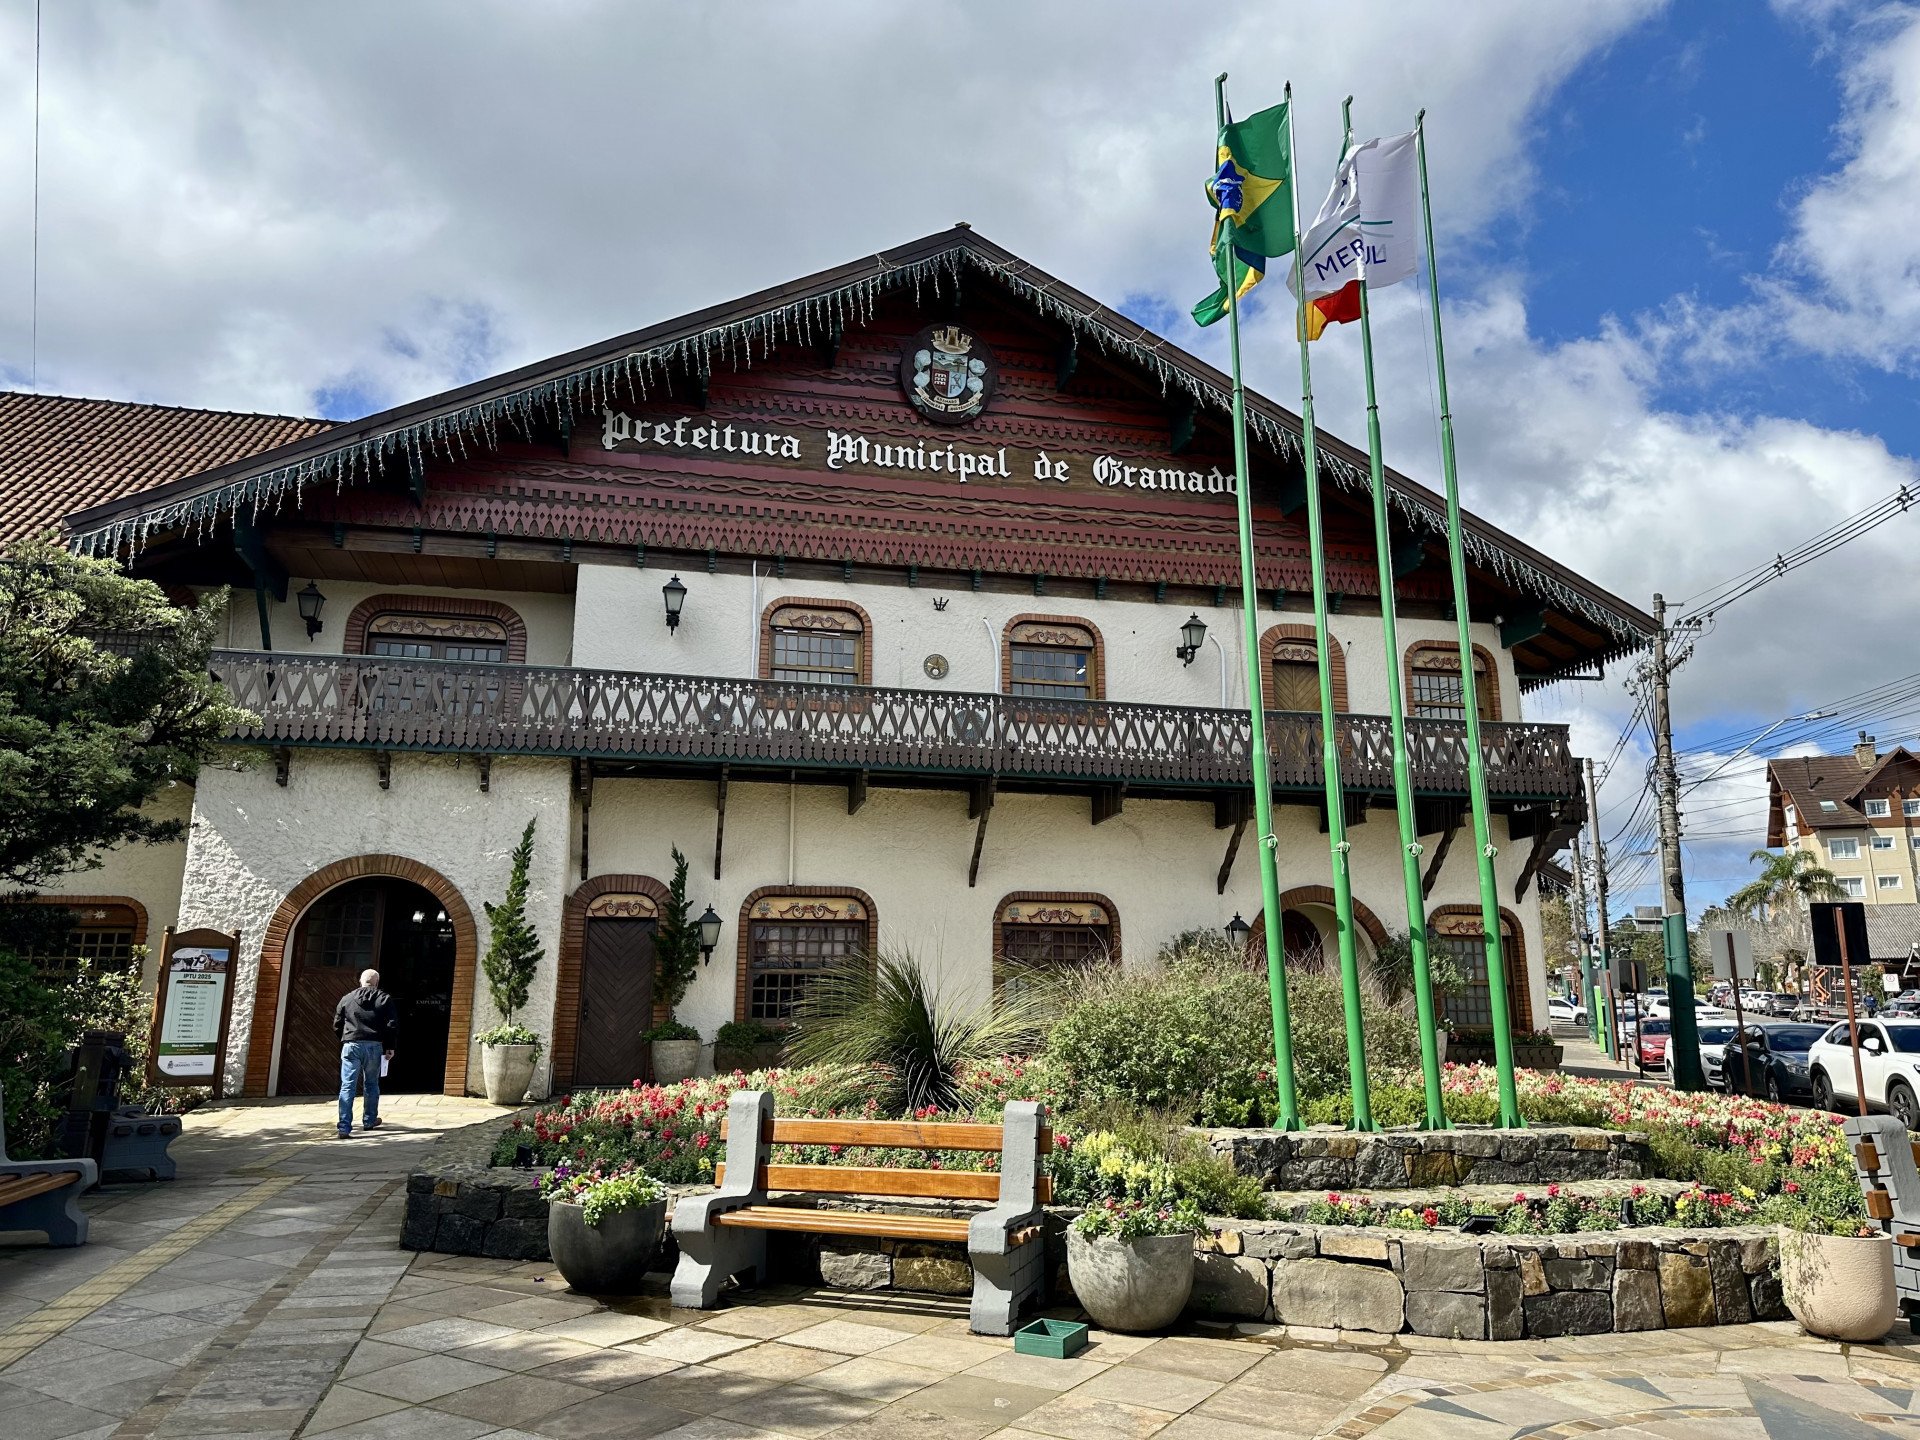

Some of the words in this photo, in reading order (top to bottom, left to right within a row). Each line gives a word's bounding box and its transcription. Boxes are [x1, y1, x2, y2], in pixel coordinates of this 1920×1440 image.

[602, 408, 802, 459] Prefeitura
[827, 429, 1012, 483] Municipal
[1033, 451, 1070, 482] de
[1092, 455, 1238, 495] Gramado
